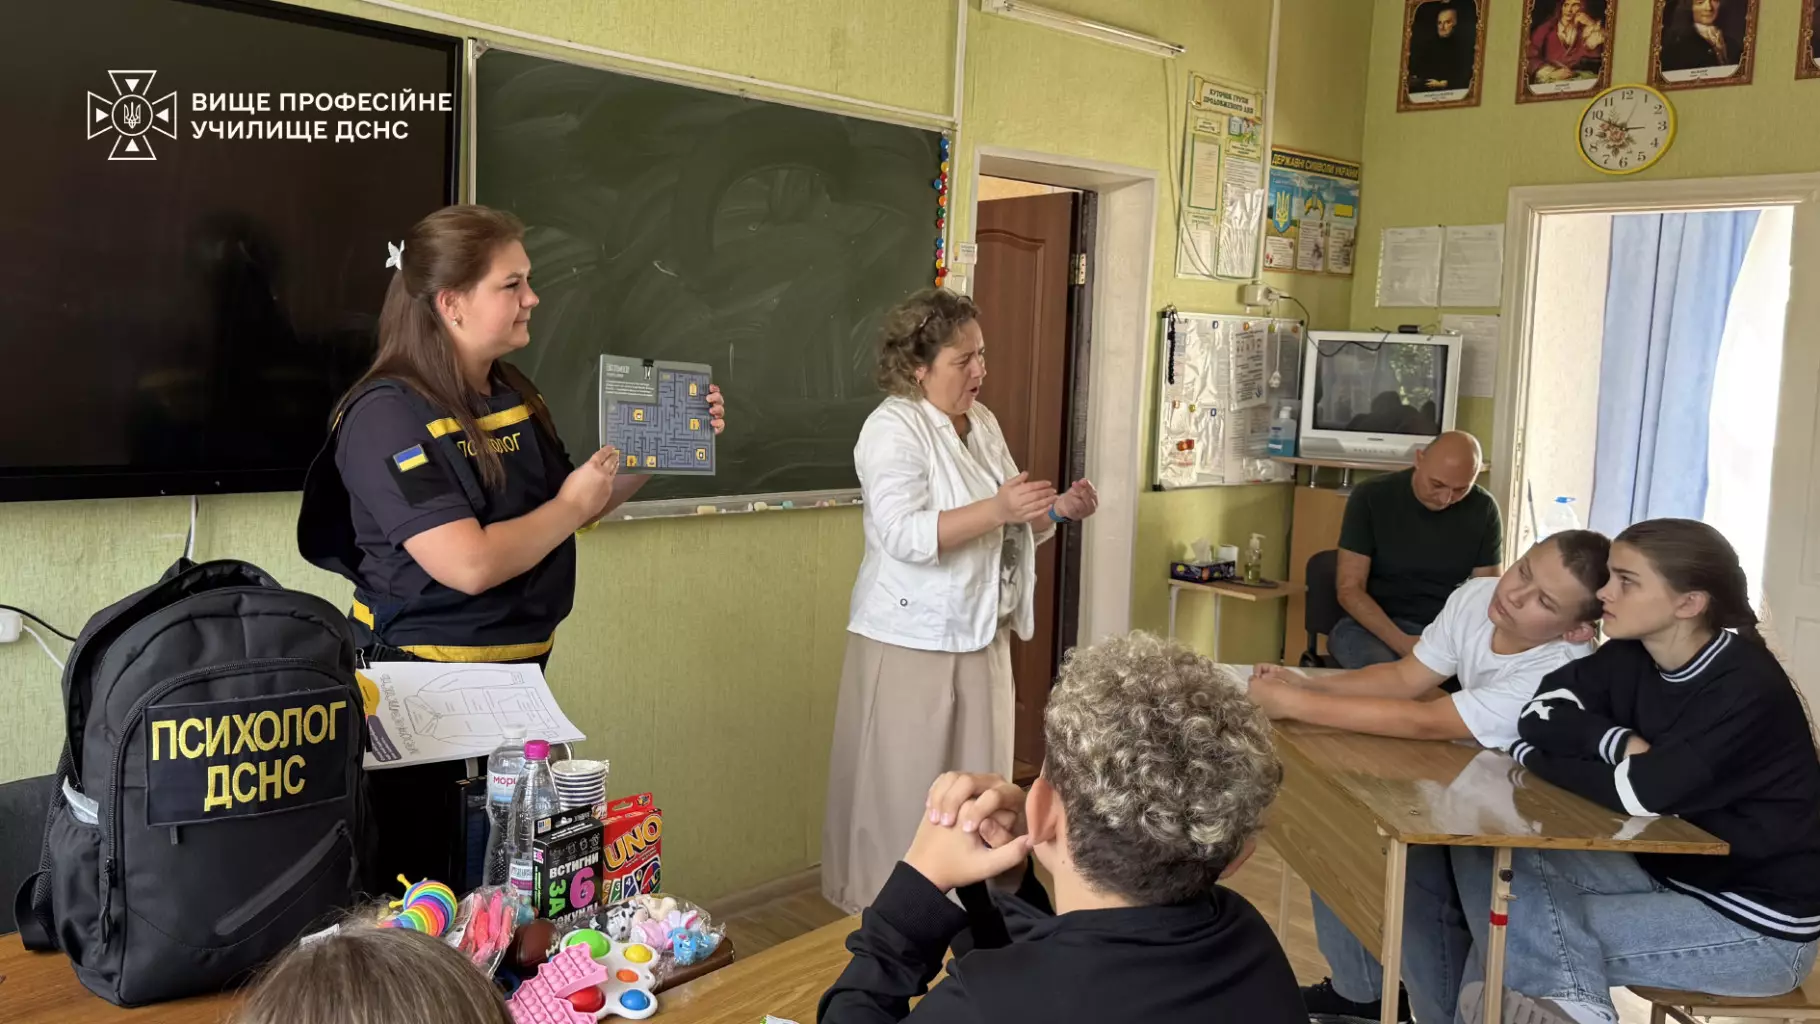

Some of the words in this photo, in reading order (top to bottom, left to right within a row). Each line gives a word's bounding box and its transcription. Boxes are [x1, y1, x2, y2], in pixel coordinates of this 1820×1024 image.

[1621, 90, 1634, 100] 12
[1644, 94, 1648, 103] 1
[1604, 97, 1613, 107] 11
[1592, 110, 1604, 120] 10
[1654, 104, 1662, 115] 2
[1658, 121, 1667, 131] 3
[1585, 127, 1594, 138] 9
[1589, 144, 1598, 152] 8
[1650, 137, 1659, 148] 4
[1602, 155, 1611, 165] 7
[1619, 157, 1628, 168] 6
[1637, 152, 1646, 162] 5
[1272, 154, 1305, 168] ДЕРЖАВНІ
[1305, 160, 1334, 173] СИМВОЛИ
[1334, 166, 1358, 178] УКРАЇНИ
[456, 432, 521, 458] ПСОЛОГ
[151, 700, 347, 761] ПСИХОЛОГ
[203, 754, 306, 812] ДСНС
[603, 814, 663, 872] UNO
[549, 852, 599, 879] ВСТИГНИ
[615, 882, 621, 891] 3
[625, 878, 631, 886] 4
[549, 879, 566, 917] ЗА
[569, 866, 595, 909] 6
